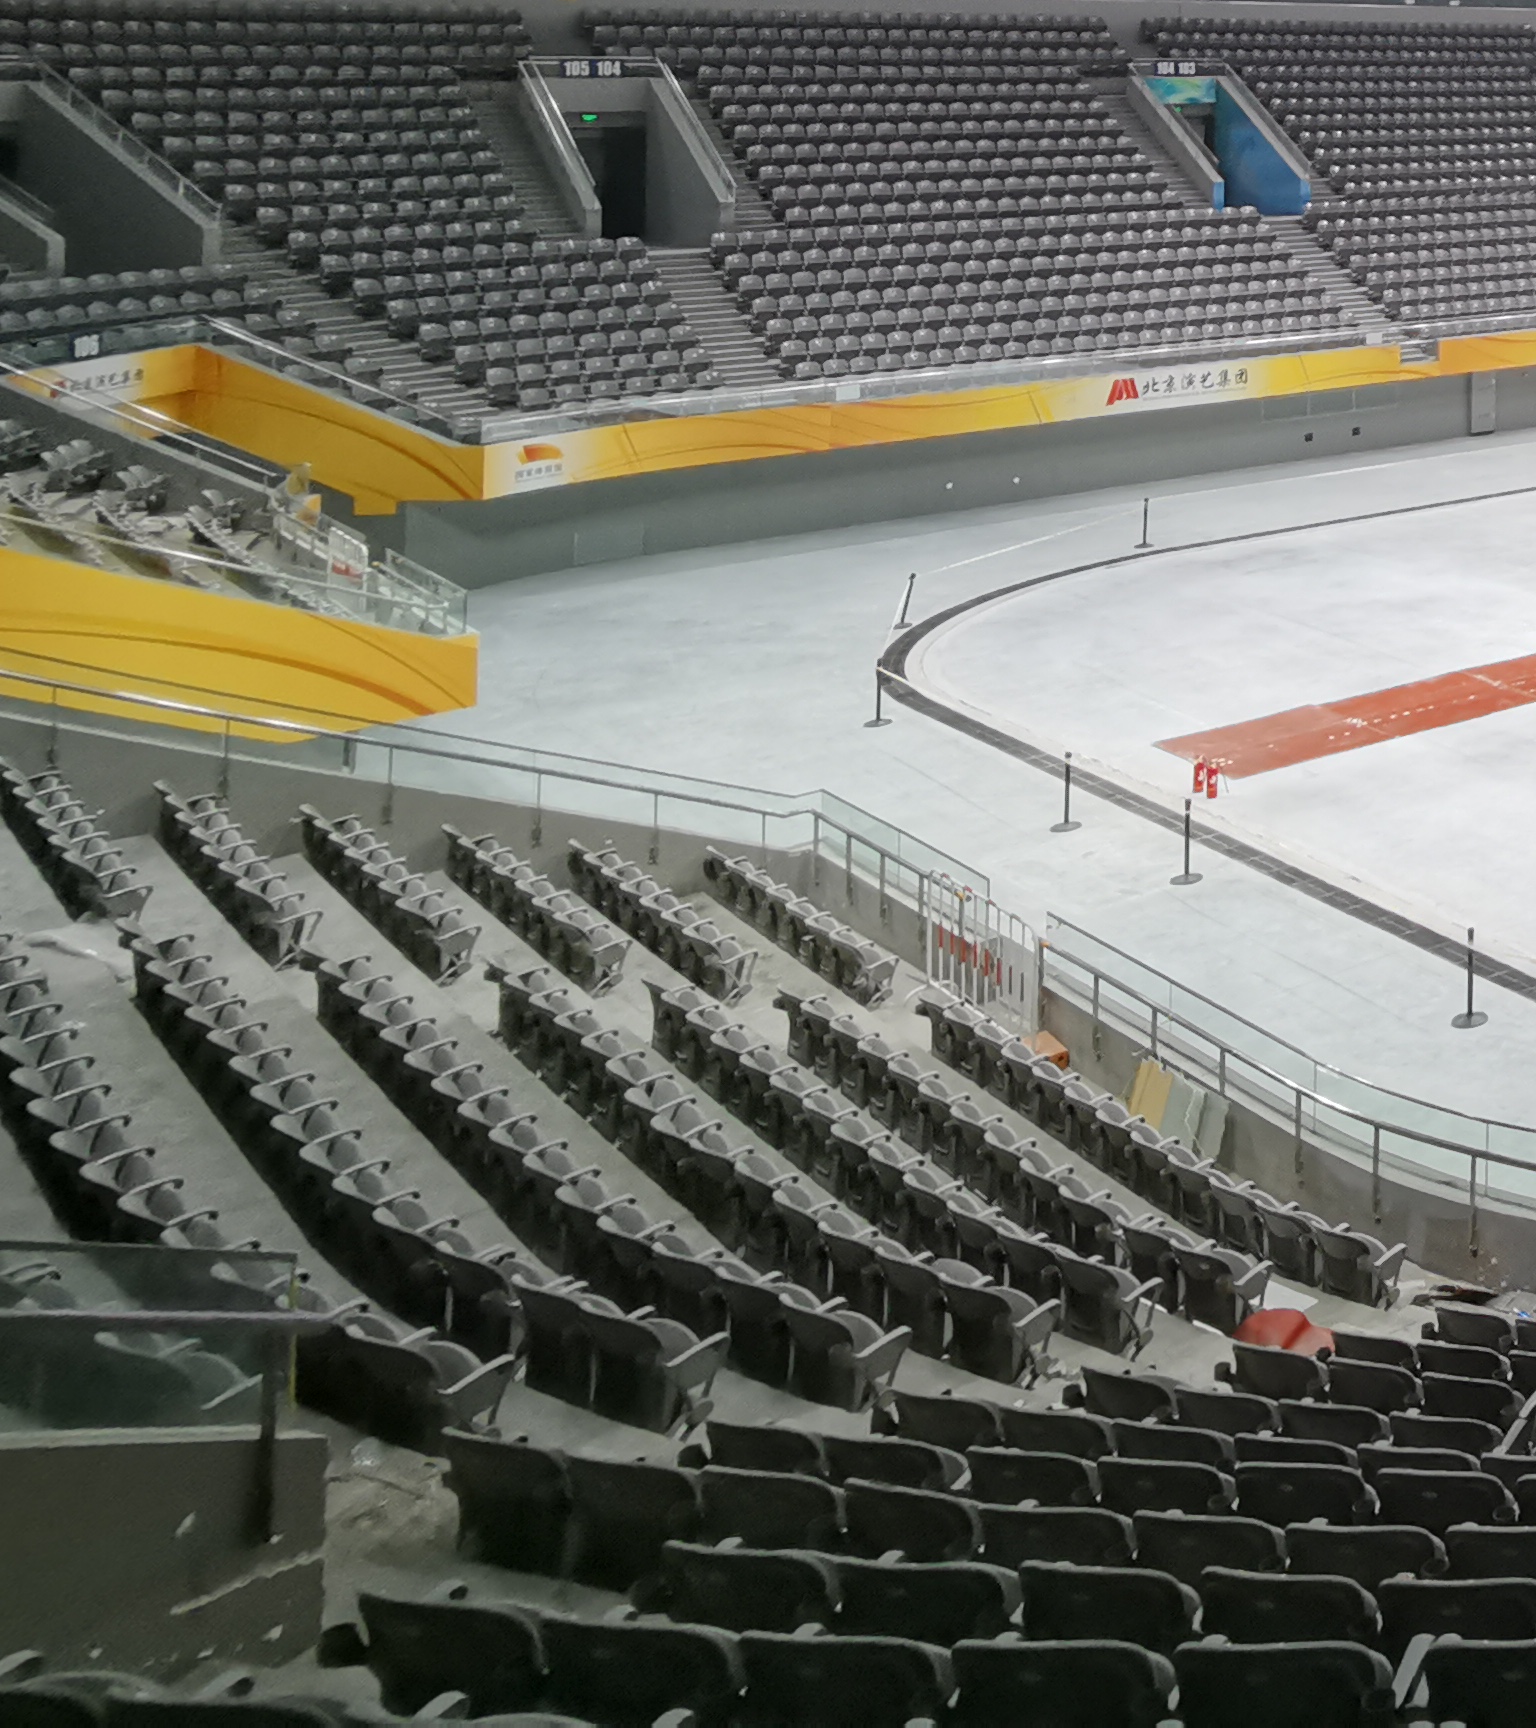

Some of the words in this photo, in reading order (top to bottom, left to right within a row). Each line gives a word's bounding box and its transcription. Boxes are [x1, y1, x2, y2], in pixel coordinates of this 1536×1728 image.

[563, 60, 590, 76] 105
[596, 60, 622, 76] 104
[1141, 367, 1249, 396] 北京演艺集团
